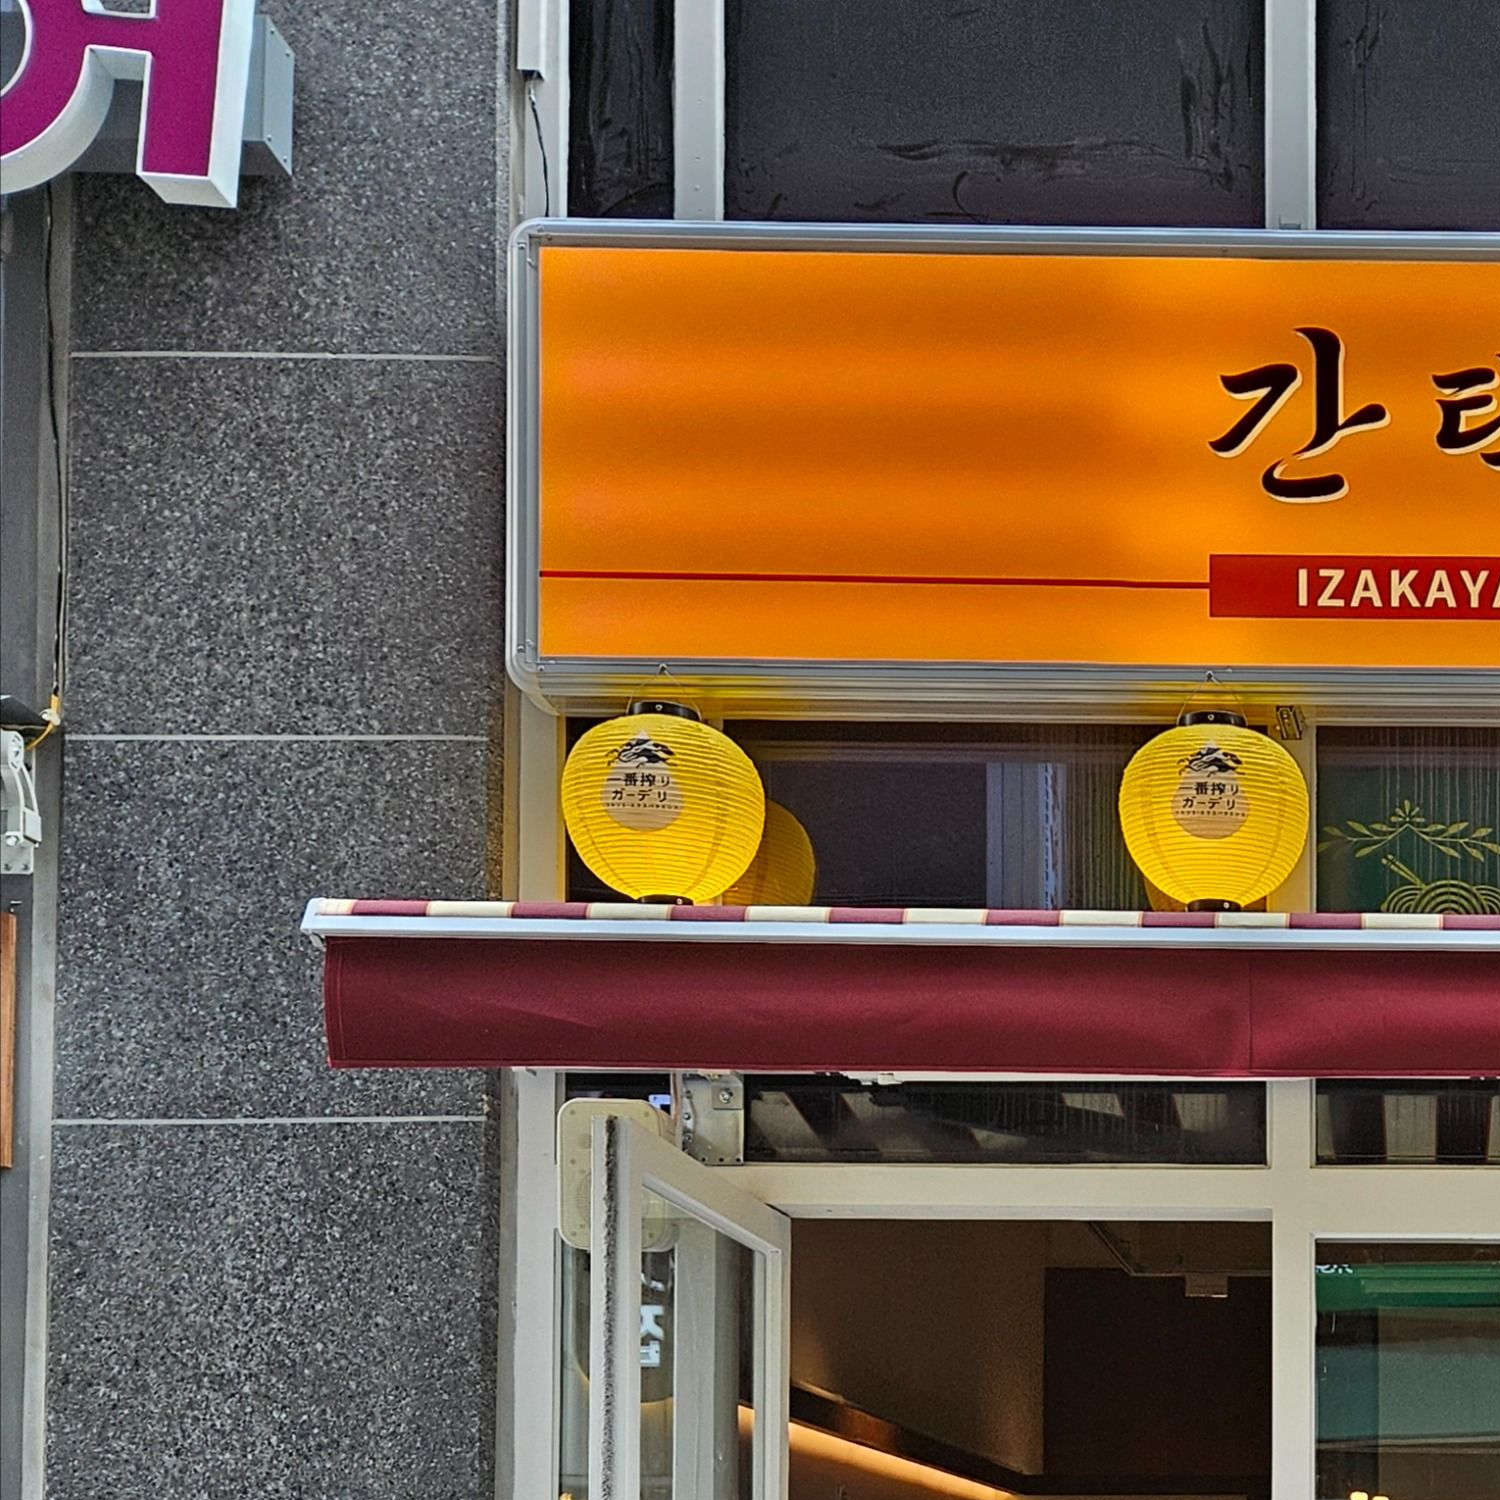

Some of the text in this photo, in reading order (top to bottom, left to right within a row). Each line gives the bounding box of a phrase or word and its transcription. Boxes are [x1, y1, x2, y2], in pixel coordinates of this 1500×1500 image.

[606, 772, 671, 788] 一番搾り
[1179, 781, 1240, 796] 一番搾り
